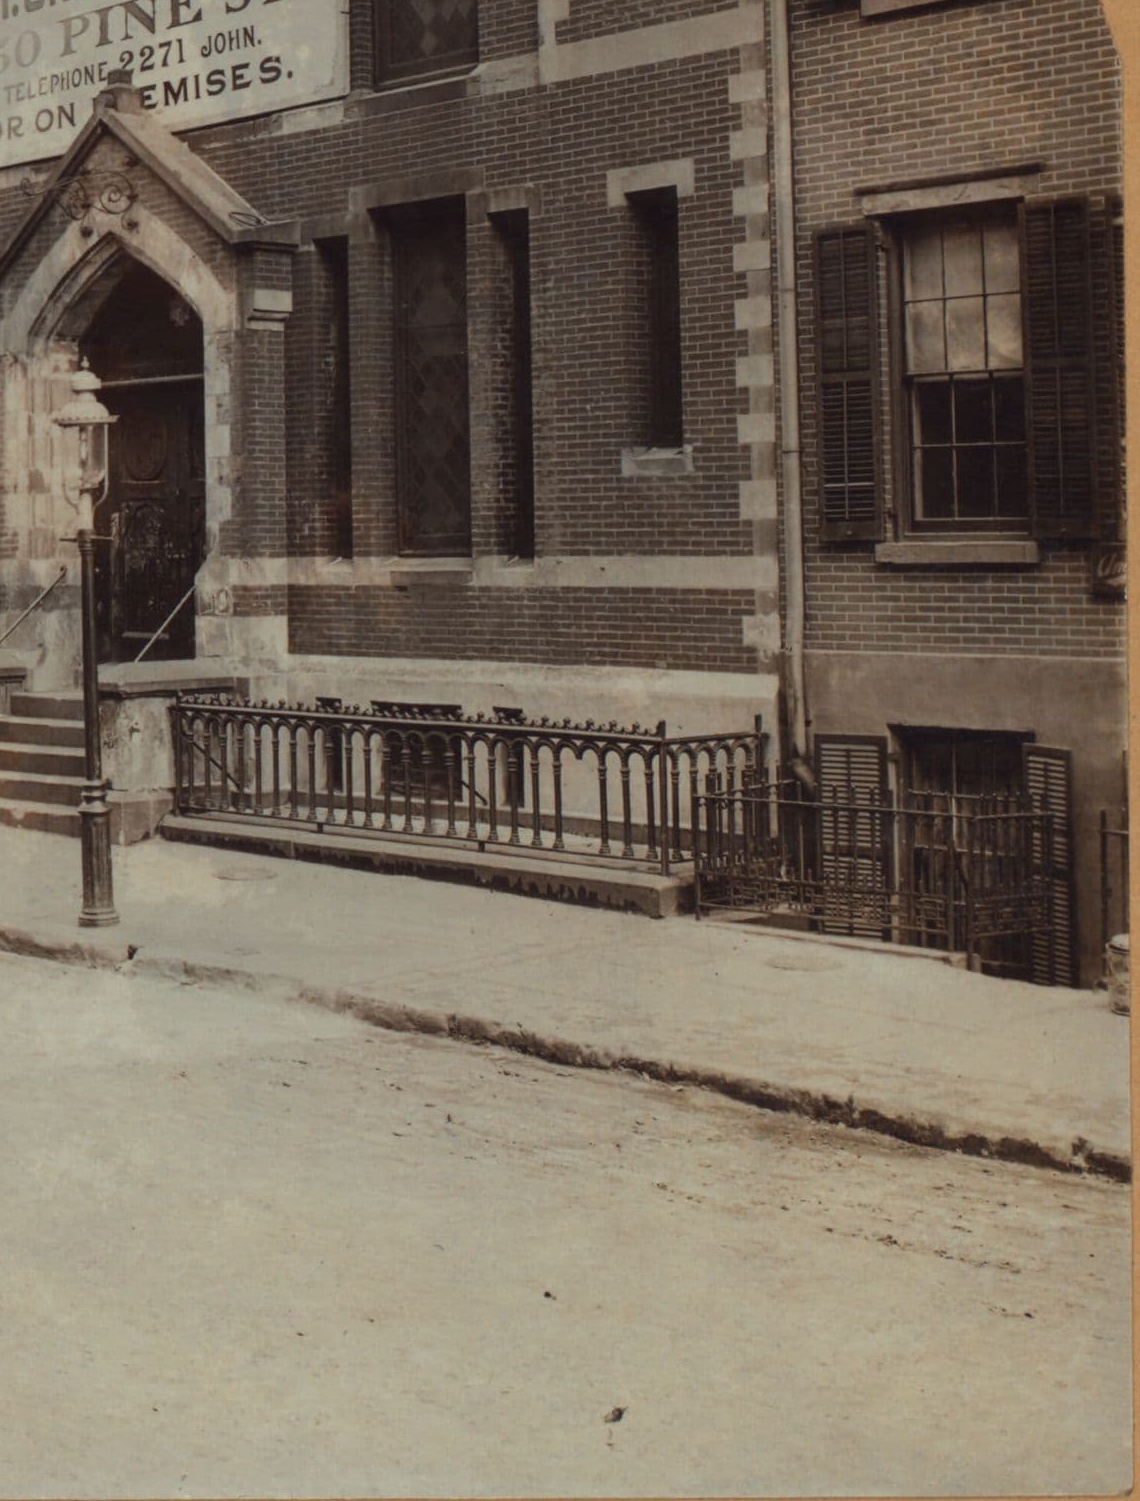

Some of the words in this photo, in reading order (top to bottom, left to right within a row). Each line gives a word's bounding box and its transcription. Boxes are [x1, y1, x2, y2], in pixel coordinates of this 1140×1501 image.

[3, 60, 108, 106] TELEPHONE
[119, 38, 184, 73] 2271
[200, 25, 263, 58] JOHN.
[35, 104, 76, 133] ON
[140, 56, 293, 110] EMISES.
